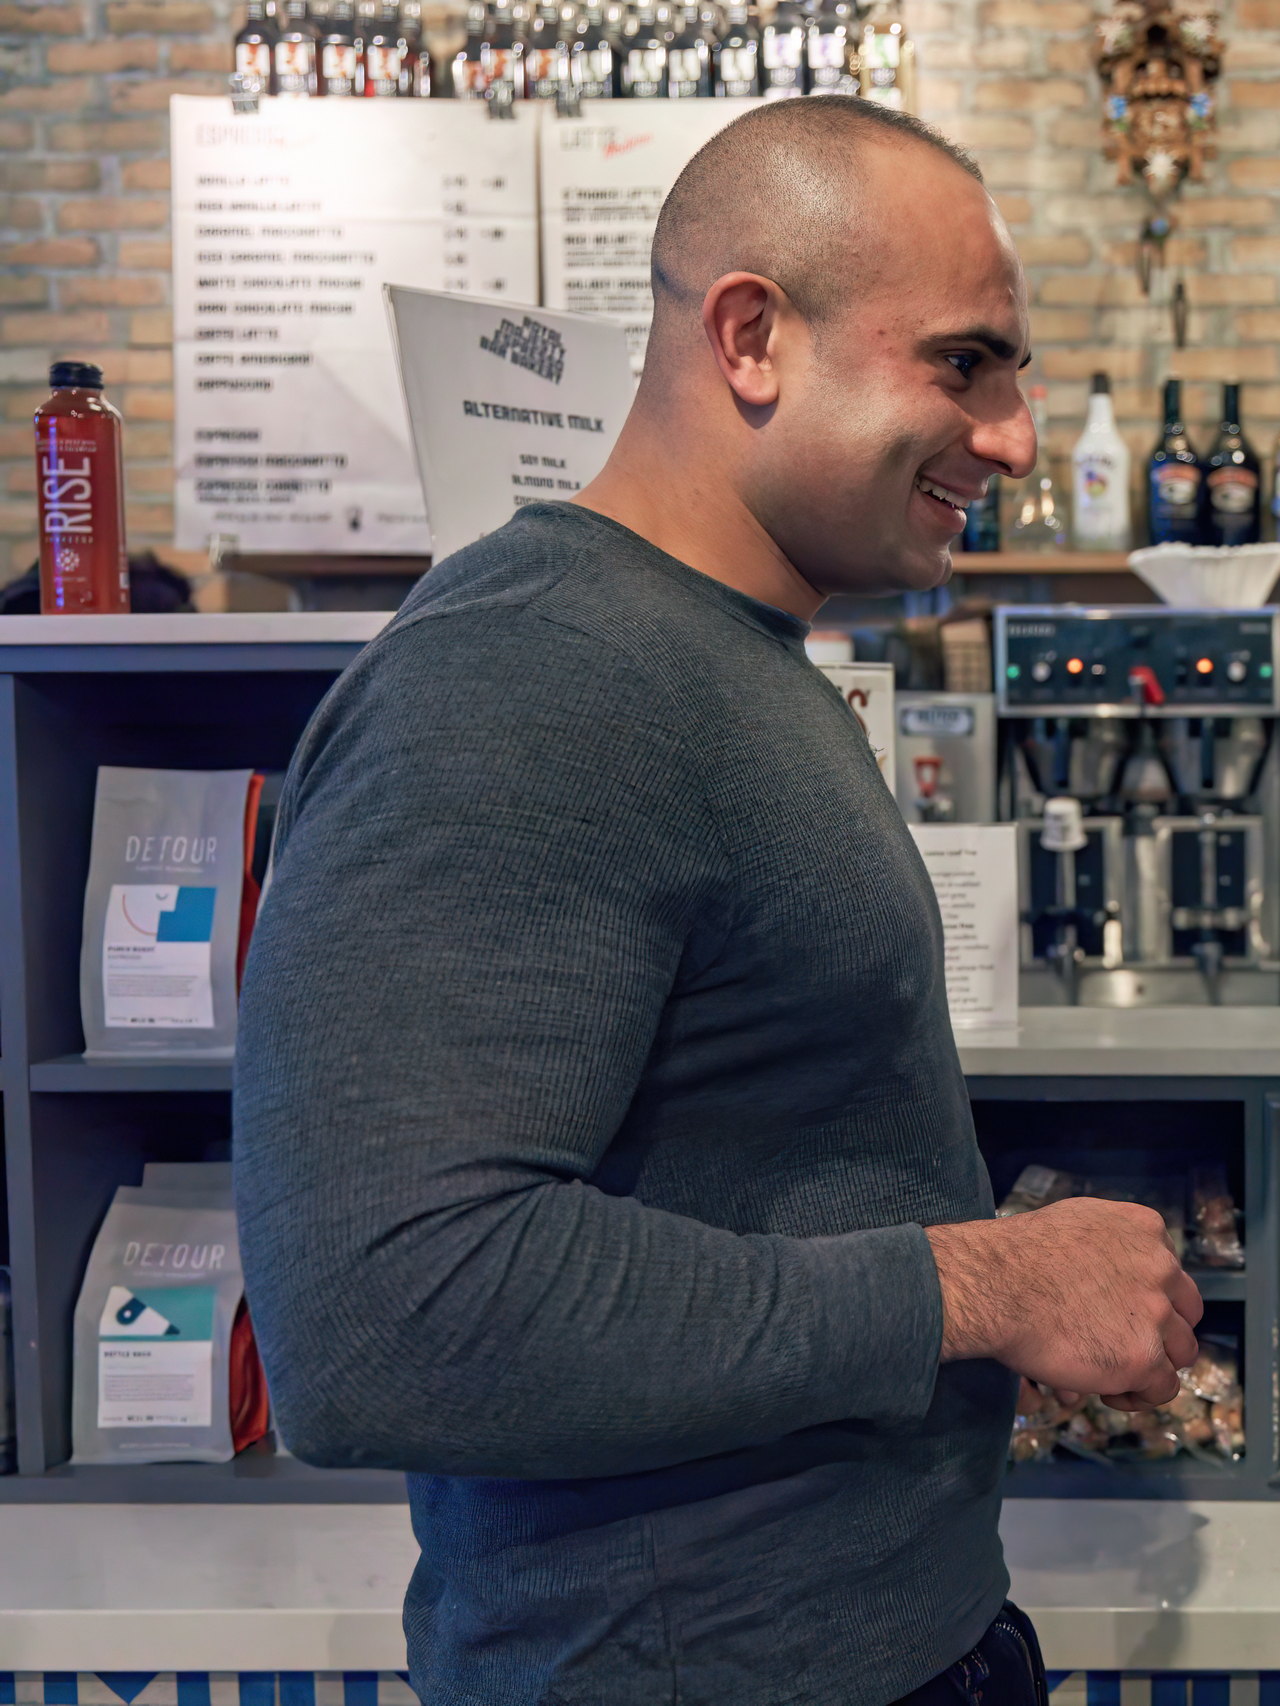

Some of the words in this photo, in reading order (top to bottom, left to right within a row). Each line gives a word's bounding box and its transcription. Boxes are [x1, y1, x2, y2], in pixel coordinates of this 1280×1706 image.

[463, 400, 564, 428] ALTERNATIVE
[567, 415, 605, 433] MILK
[519, 454, 539, 467] SOY
[541, 457, 567, 470] MILK
[43, 456, 93, 533] RISE
[512, 474, 554, 490] ALMOND
[557, 478, 581, 491] MILK
[125, 835, 217, 864] DETOUR
[123, 1241, 225, 1270] DETOUR
